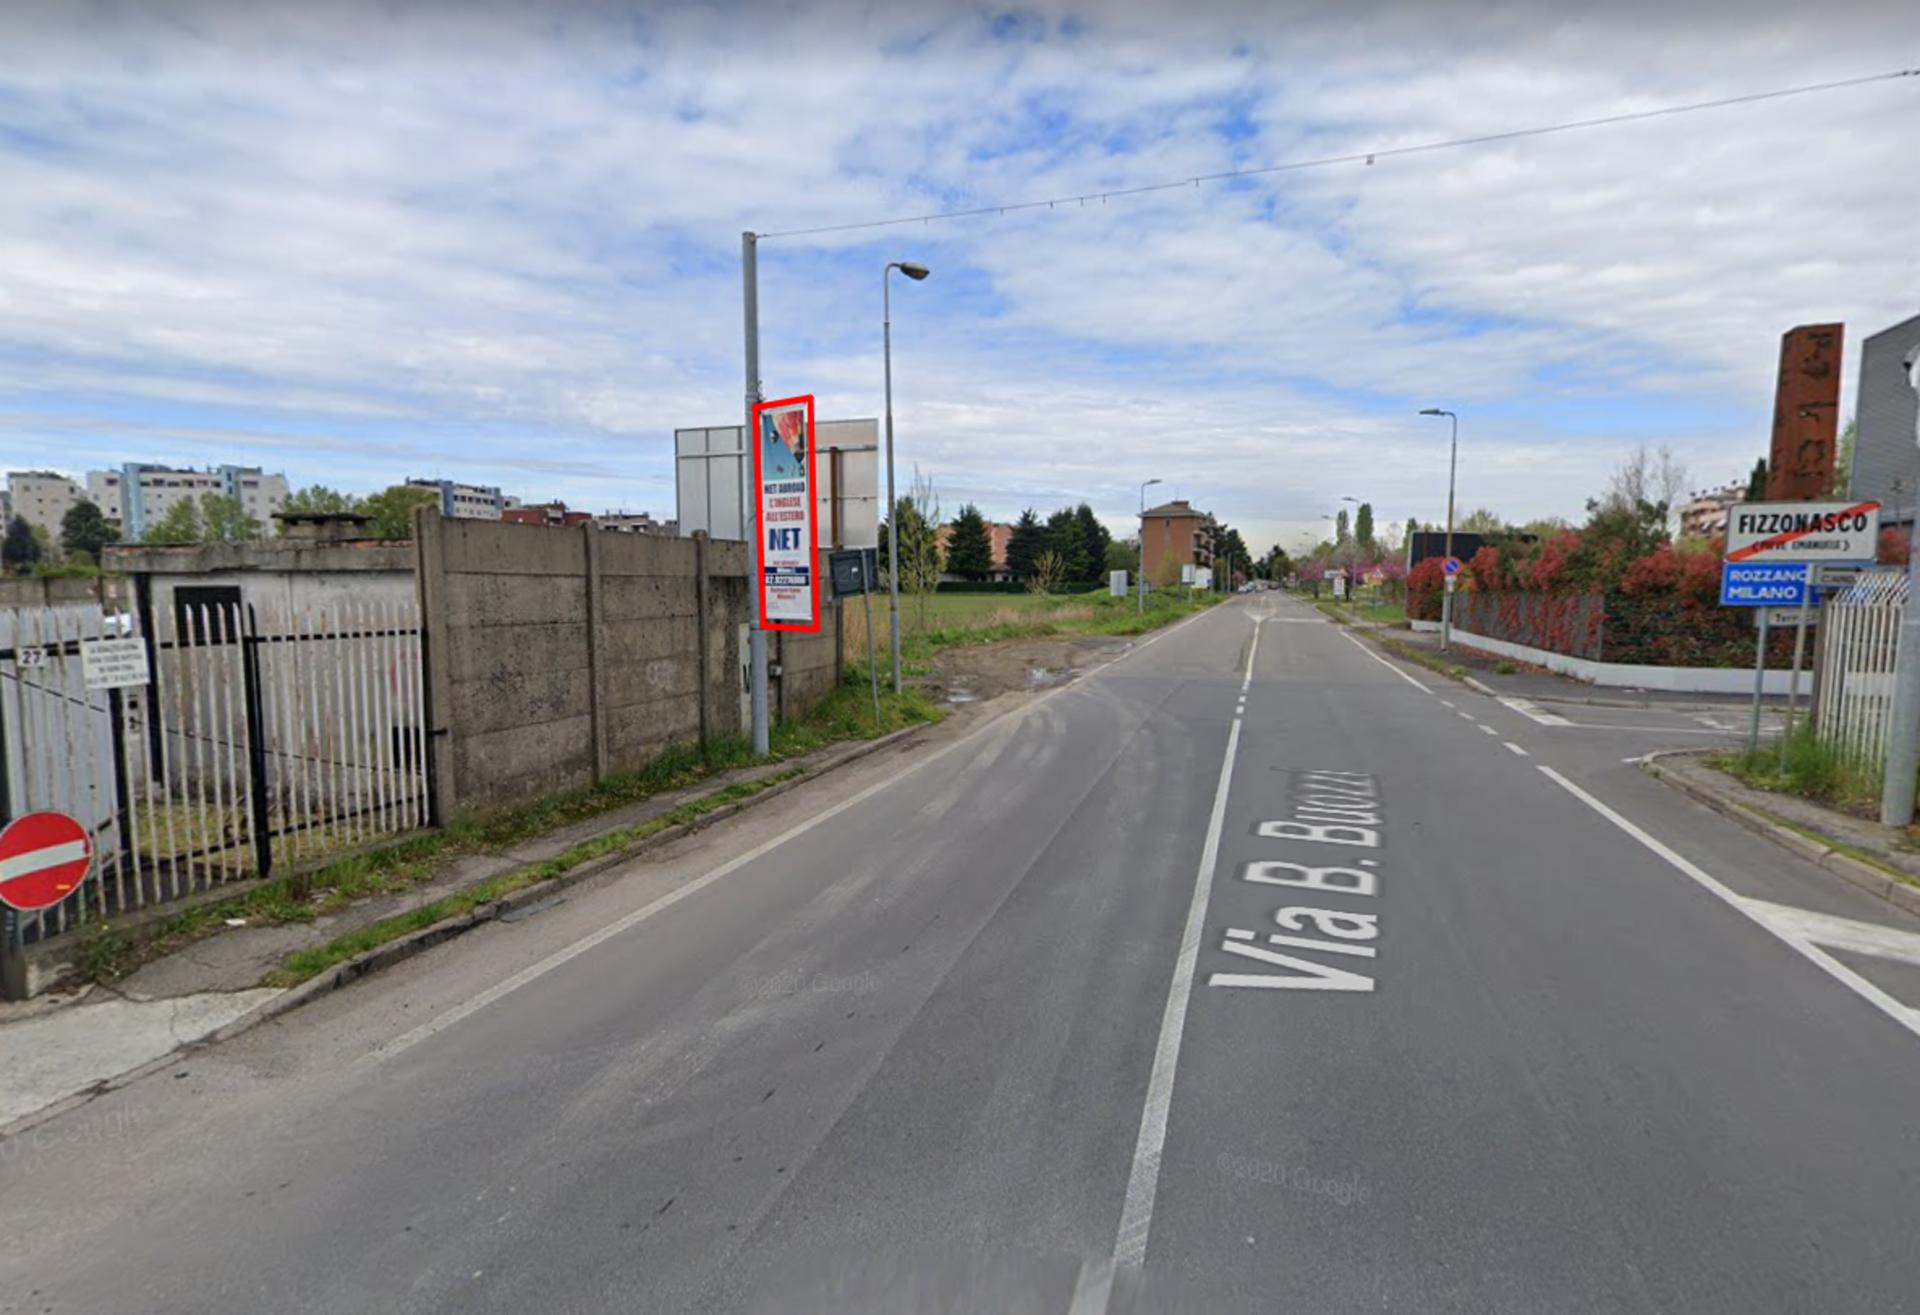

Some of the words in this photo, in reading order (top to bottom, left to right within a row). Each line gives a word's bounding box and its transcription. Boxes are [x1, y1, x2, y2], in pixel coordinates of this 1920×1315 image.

[1738, 513, 1868, 534] FIZZONASCO
[769, 528, 801, 551] NET
[1729, 569, 1808, 583] ROZZANO
[1728, 586, 1798, 600] MILANO
[22, 651, 42, 665] 27
